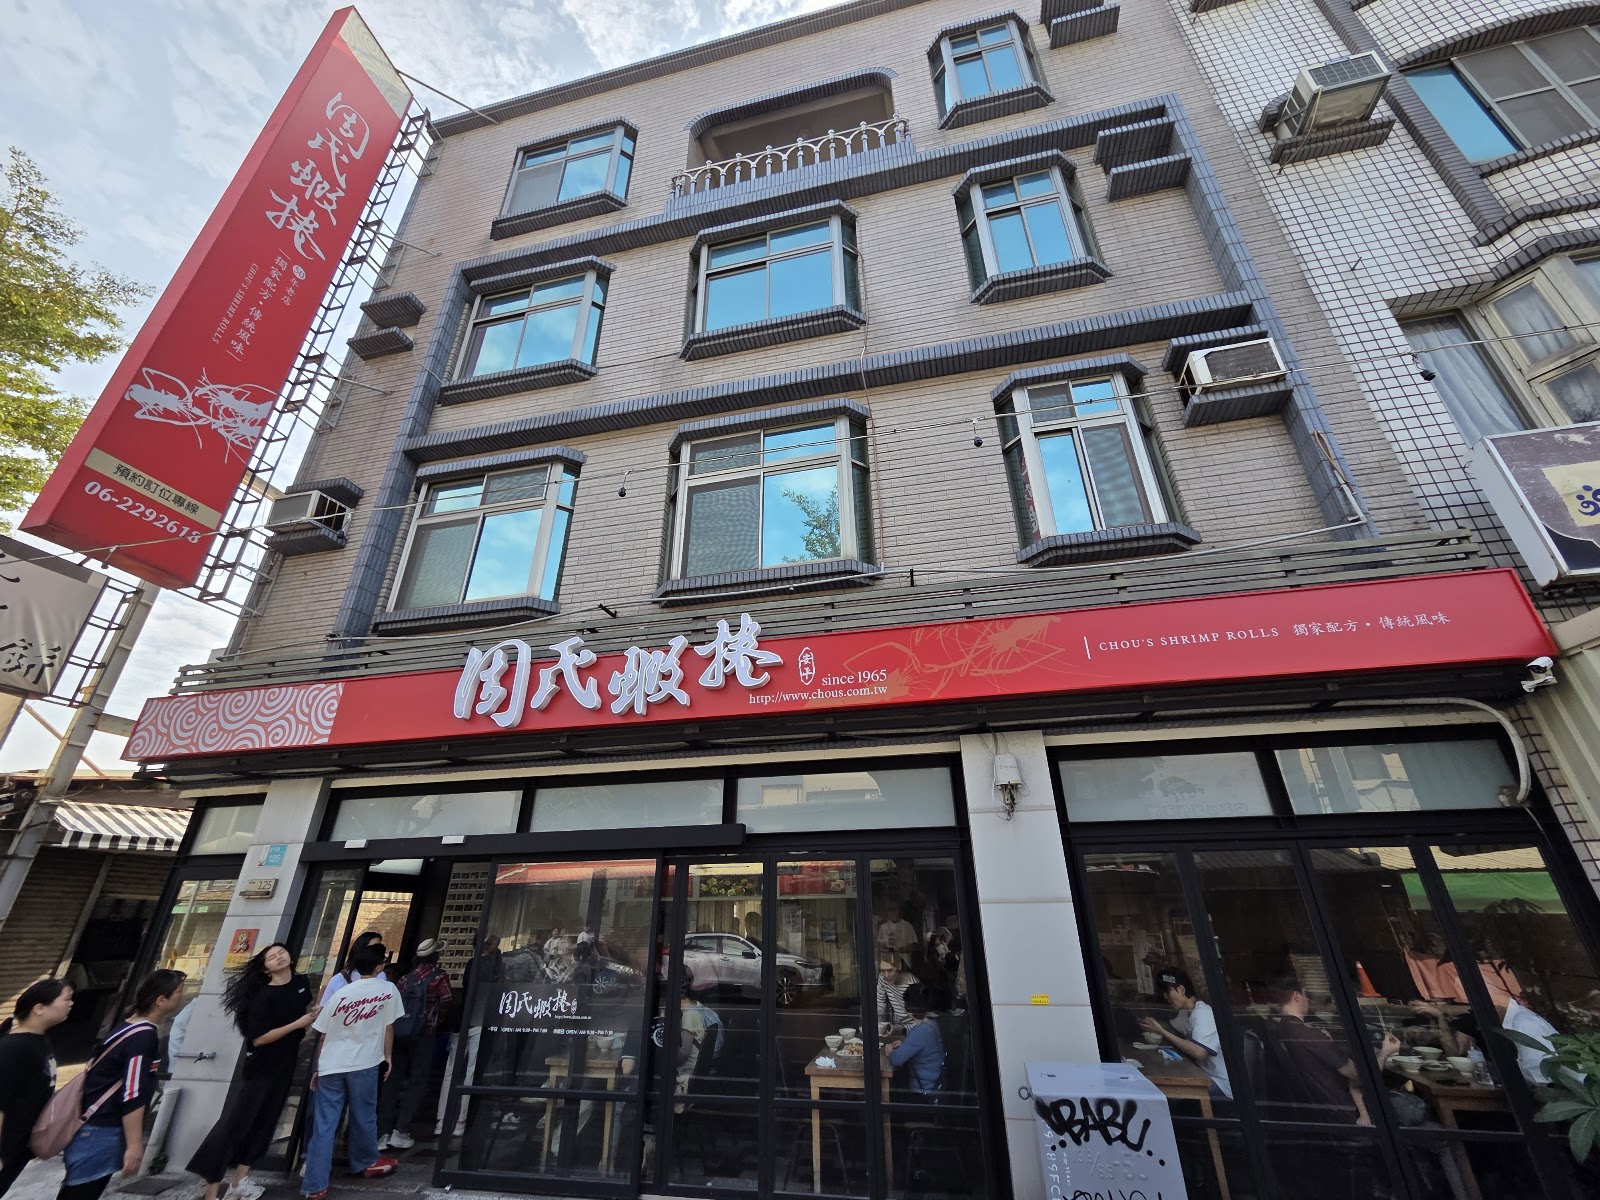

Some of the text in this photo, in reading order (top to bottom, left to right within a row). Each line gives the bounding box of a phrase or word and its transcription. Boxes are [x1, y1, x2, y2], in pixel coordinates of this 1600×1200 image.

[212, 263, 259, 344] CHOU'S SHRIMP ROLLS
[113, 463, 200, 516] 預約訂位專線
[84, 481, 202, 544] 06-2292618
[1099, 627, 1280, 651] CHOU'S SHRIMP ROLLS
[453, 612, 784, 729] 周氏蝦捲
[822, 669, 887, 686] since 1965
[749, 685, 888, 705] http://www.chous.com.tw
[269, 854, 281, 863] 125
[257, 881, 273, 890] 125
[331, 992, 393, 1018] Insomnia
[343, 1004, 378, 1027] Club
